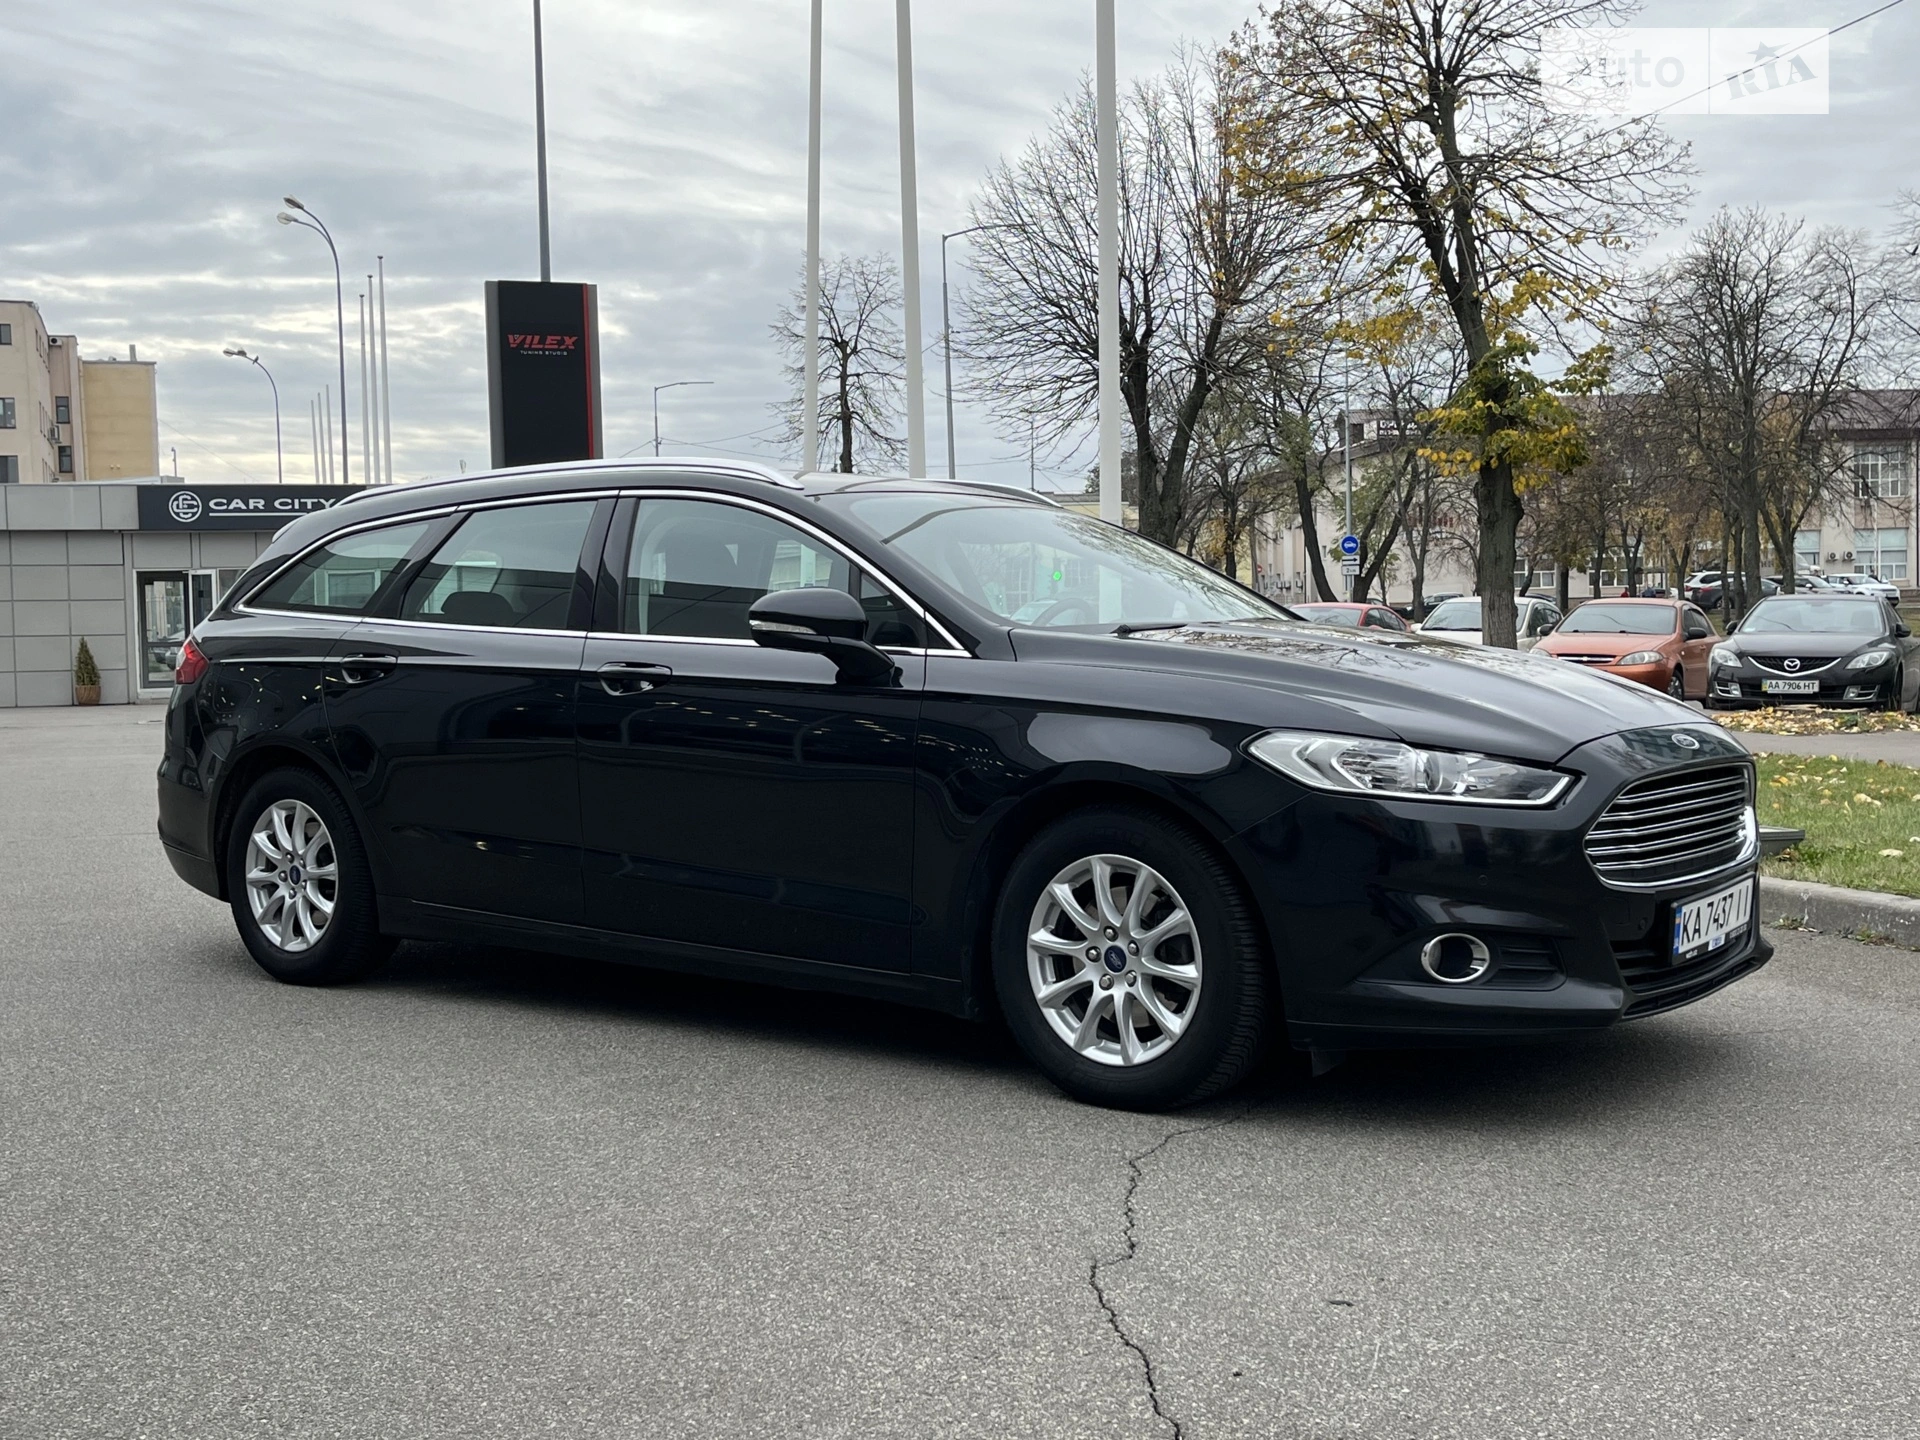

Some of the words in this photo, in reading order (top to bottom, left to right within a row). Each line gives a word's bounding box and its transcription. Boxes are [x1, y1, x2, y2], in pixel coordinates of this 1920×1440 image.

[508, 335, 578, 349] VILEX
[208, 498, 265, 510] CAR
[273, 498, 336, 510] CITY
[1768, 682, 1780, 690] AA
[1782, 682, 1802, 690] 7906
[1803, 682, 1816, 690] HT
[1681, 906, 1702, 947] KA
[1705, 892, 1734, 937] 7437
